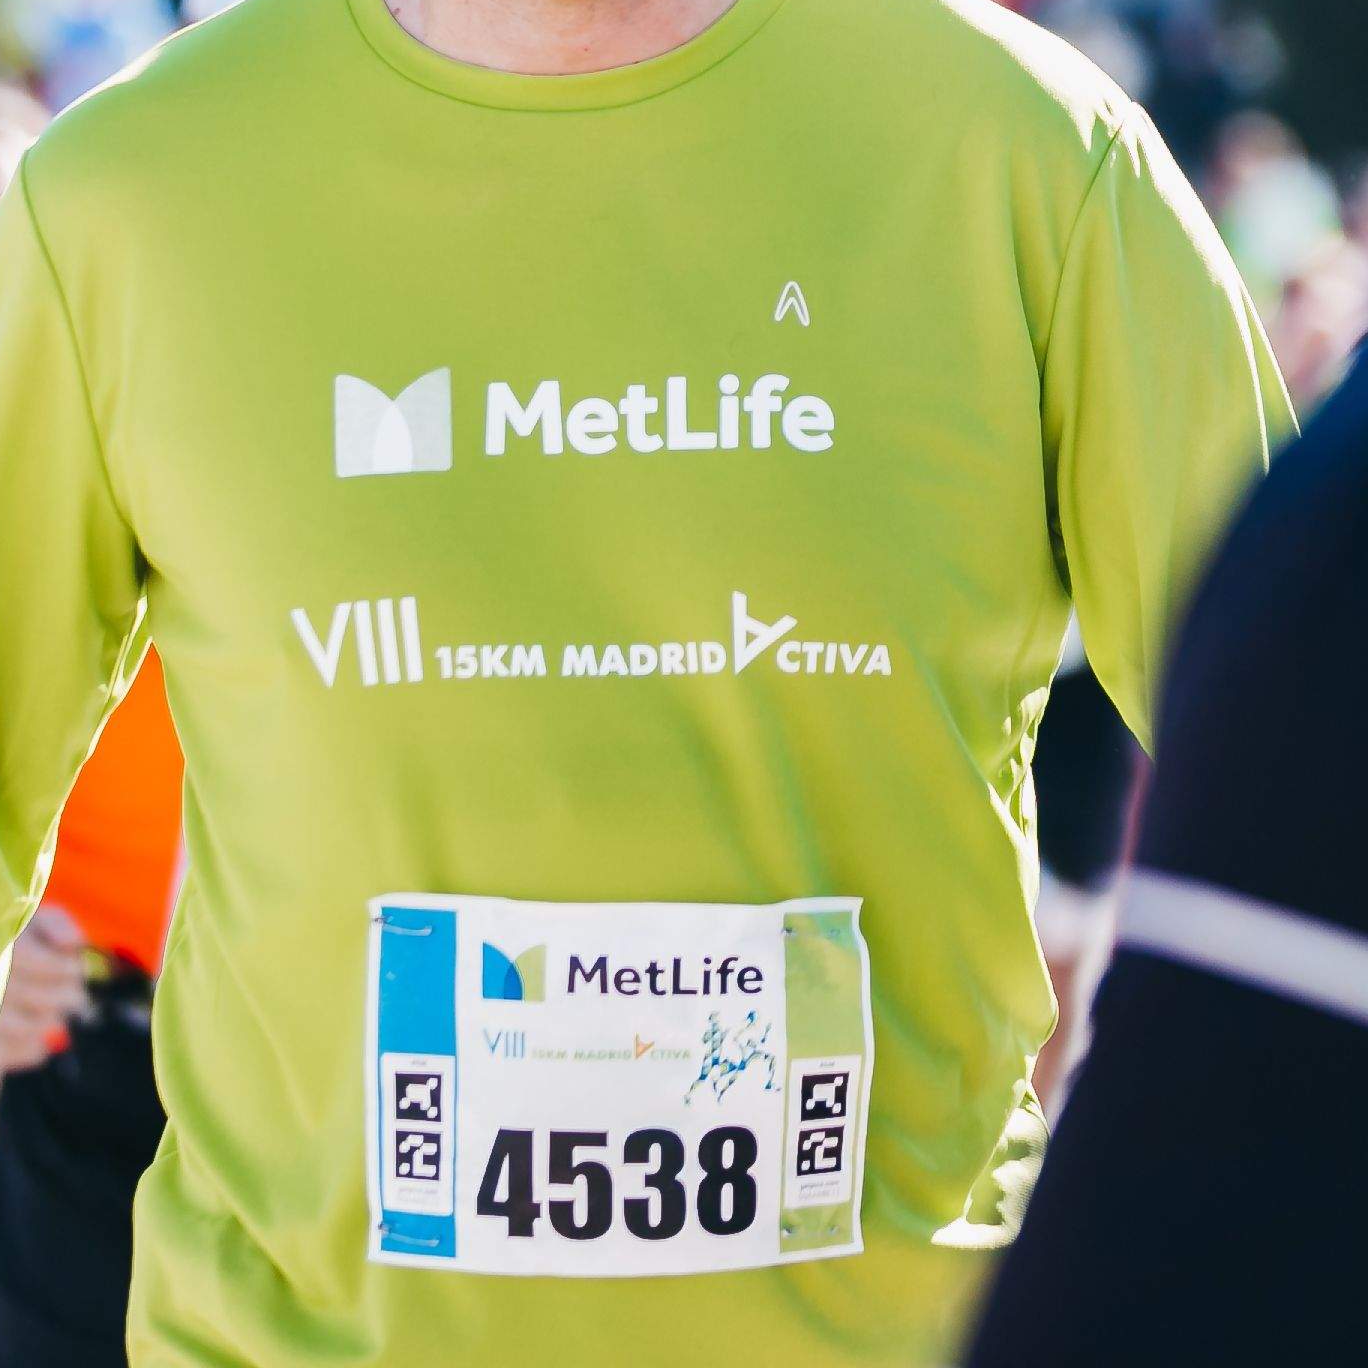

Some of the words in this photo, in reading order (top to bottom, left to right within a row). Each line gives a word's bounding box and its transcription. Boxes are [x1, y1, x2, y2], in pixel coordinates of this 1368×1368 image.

[485, 373, 834, 456] MetLife
[291, 596, 423, 688] VIII
[435, 644, 546, 679] 15KM
[561, 643, 727, 678] MADRID
[566, 954, 763, 997] MetLife
[482, 1029, 526, 1059] VIII
[573, 1048, 632, 1061] MADRID
[477, 1125, 758, 1240] 4538
